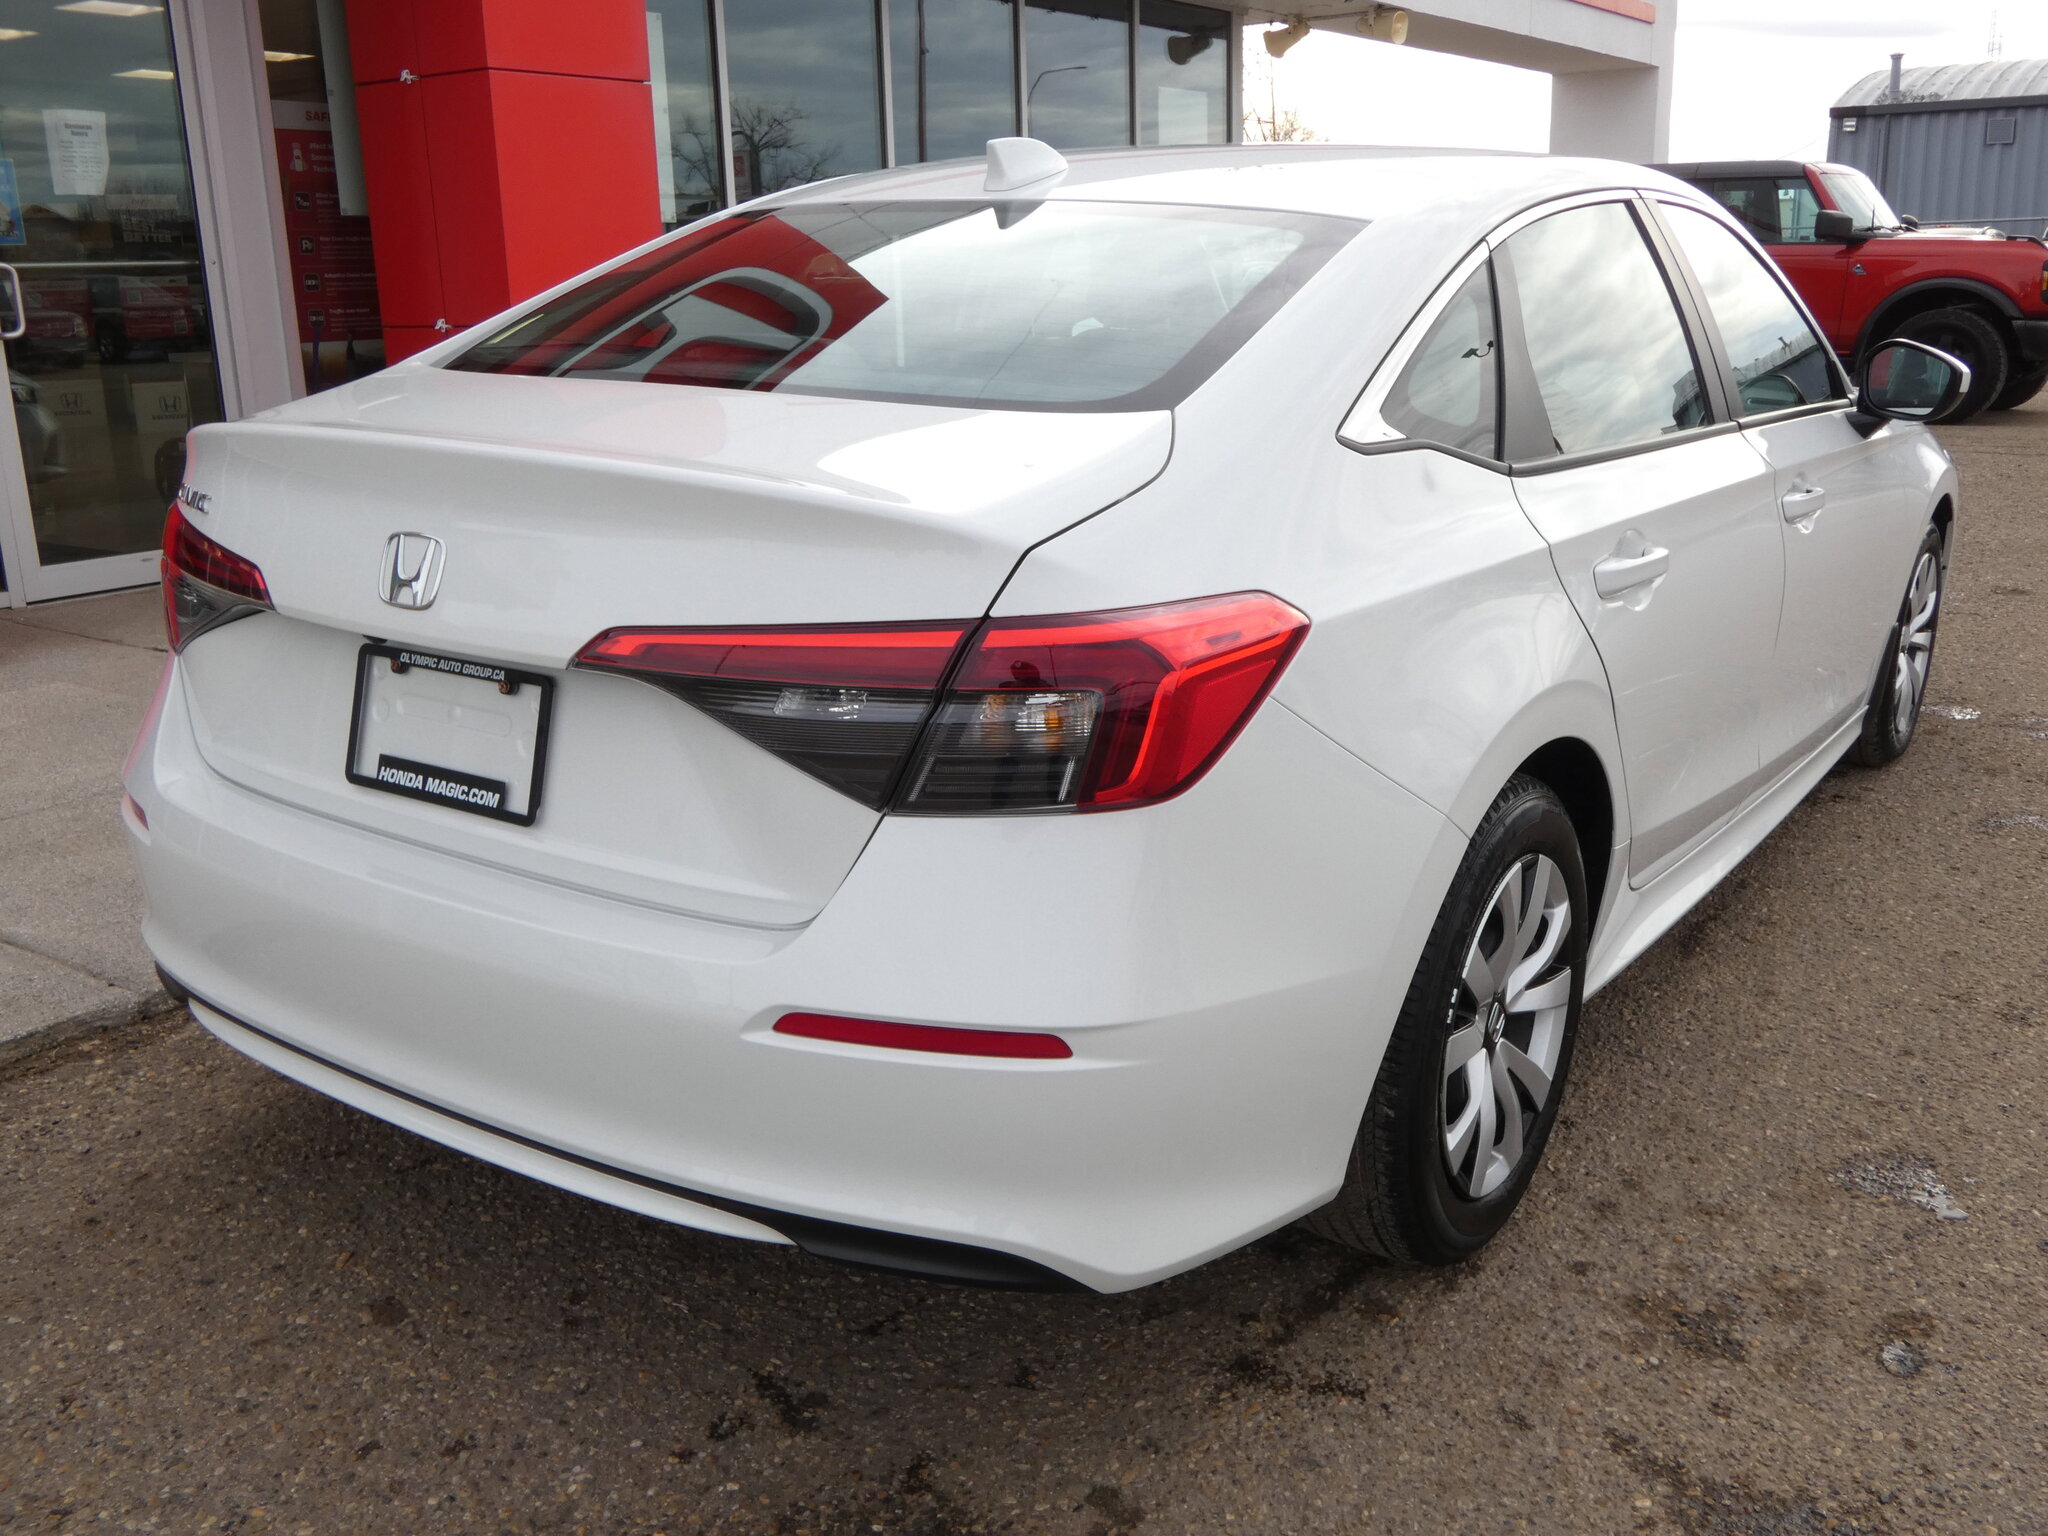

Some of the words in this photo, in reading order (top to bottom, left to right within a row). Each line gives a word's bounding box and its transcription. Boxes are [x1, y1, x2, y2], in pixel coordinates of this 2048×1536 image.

[400, 652, 439, 668] OLYMPIC
[437, 659, 461, 673] AUTO
[462, 664, 506, 681] GROUP.CA
[378, 766, 423, 790] HONDA
[424, 777, 501, 809] MAGIC.COM
